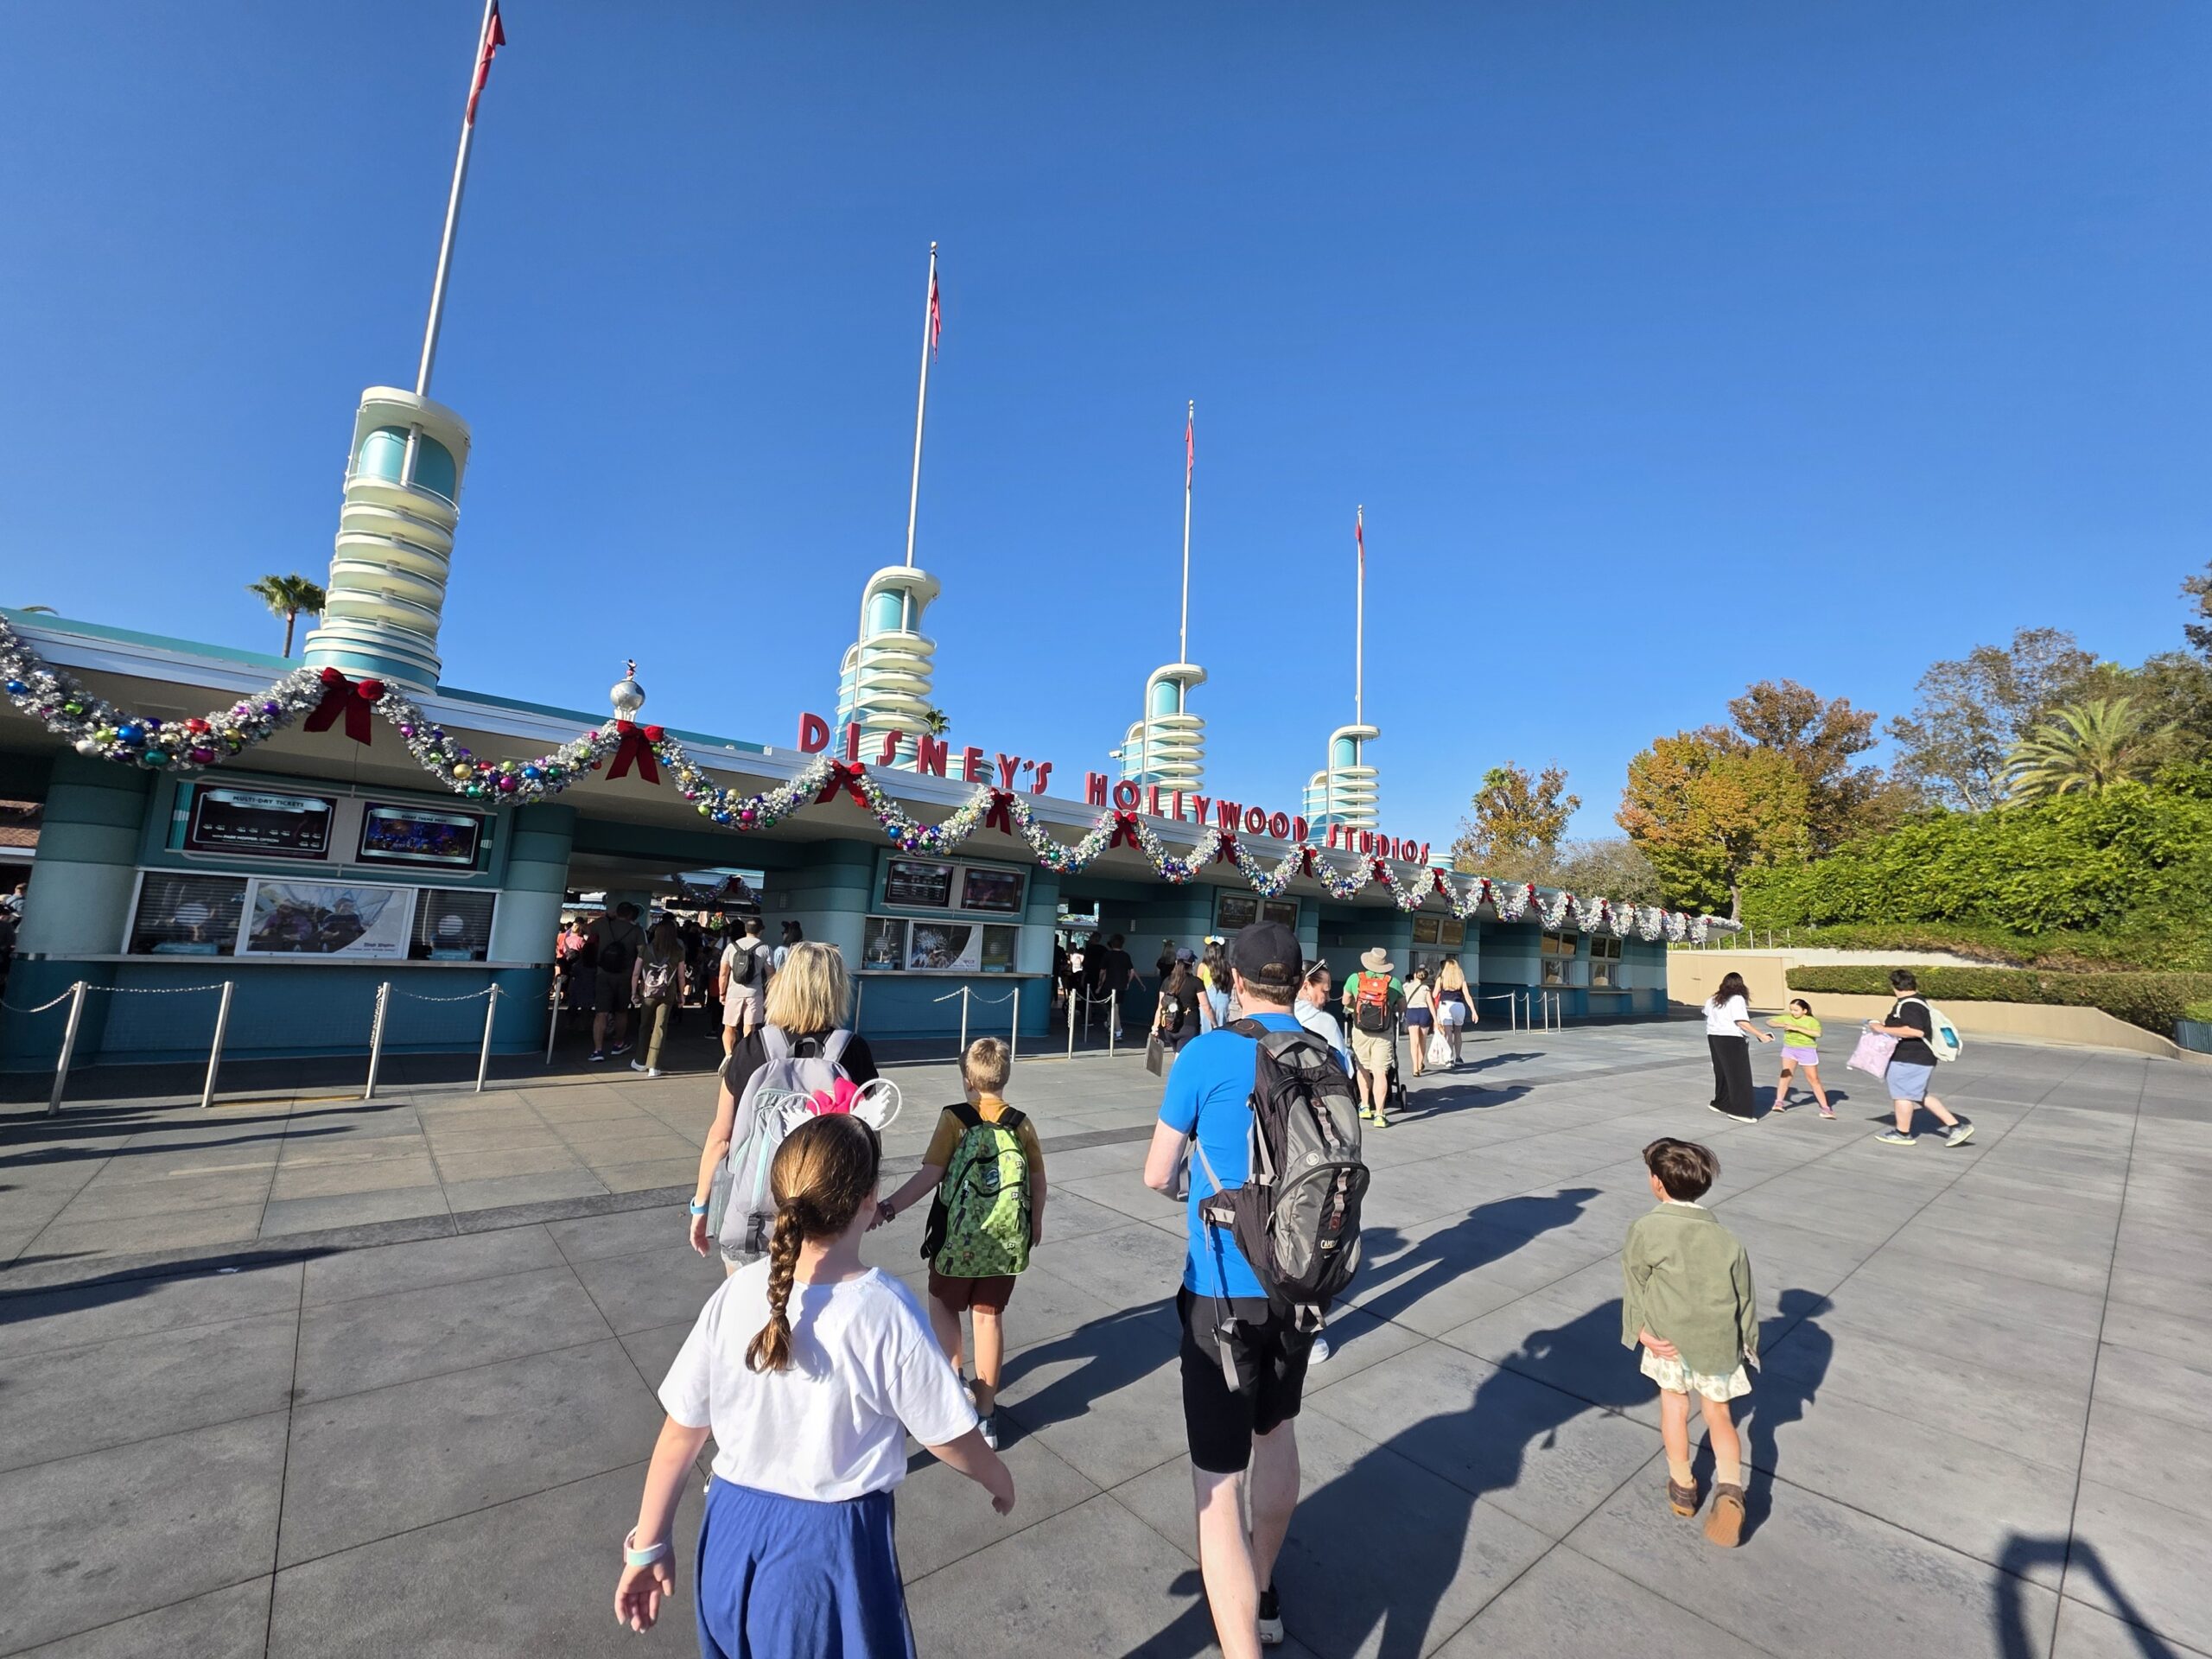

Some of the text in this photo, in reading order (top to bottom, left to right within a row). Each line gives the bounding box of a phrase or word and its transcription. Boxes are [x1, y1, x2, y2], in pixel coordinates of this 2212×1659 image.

[232, 796, 273, 804] MULTI-DAY
[797, 712, 1431, 866] DISNEY'S HOLLYWOOD STUDIOS
